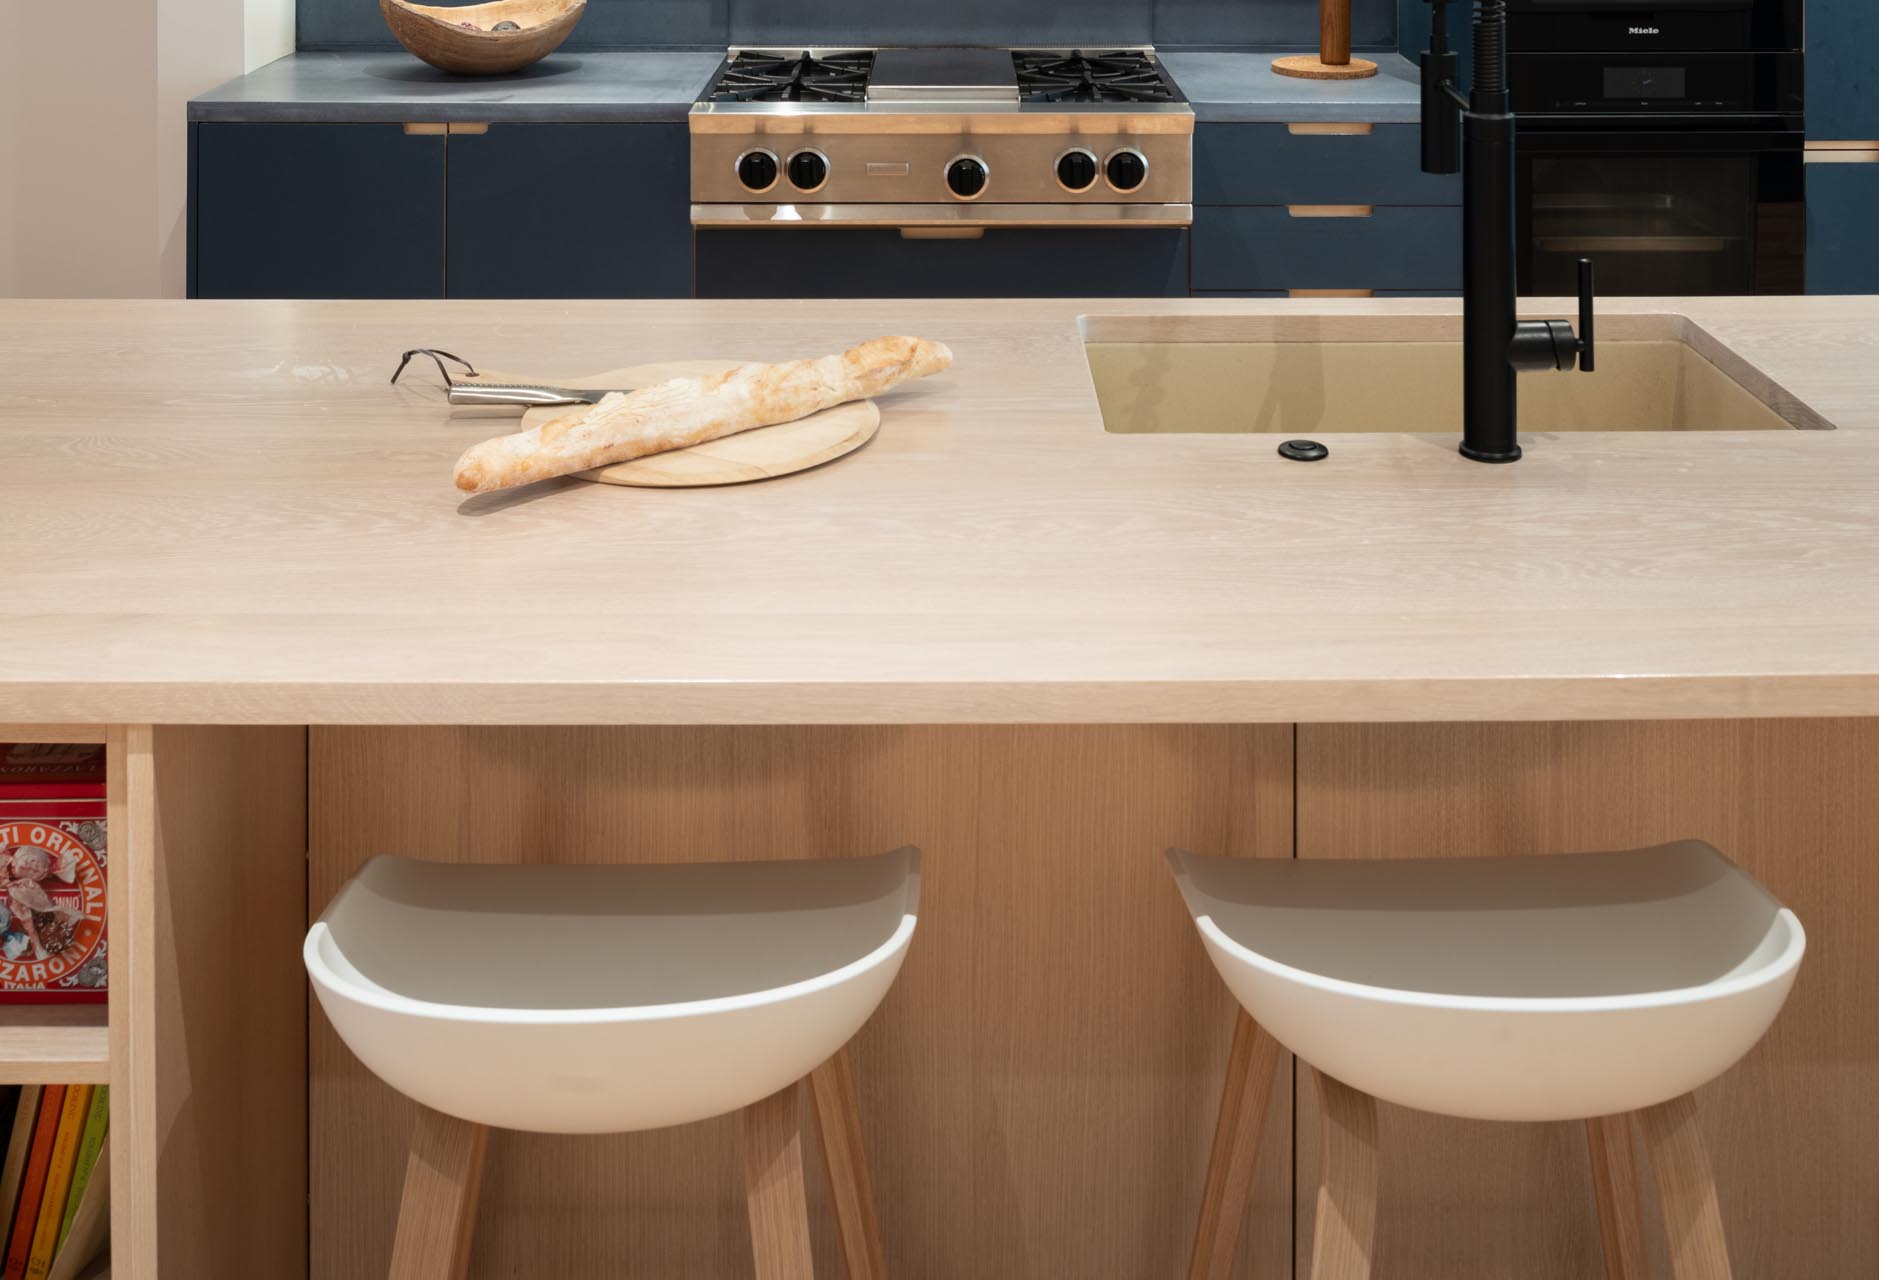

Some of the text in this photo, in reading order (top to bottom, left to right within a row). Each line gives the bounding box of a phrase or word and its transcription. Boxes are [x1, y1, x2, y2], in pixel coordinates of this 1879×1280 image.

[1628, 27, 1660, 35] Miele
[30, 826, 104, 922] ORIGINALI
[4, 981, 46, 991] ITALIA
